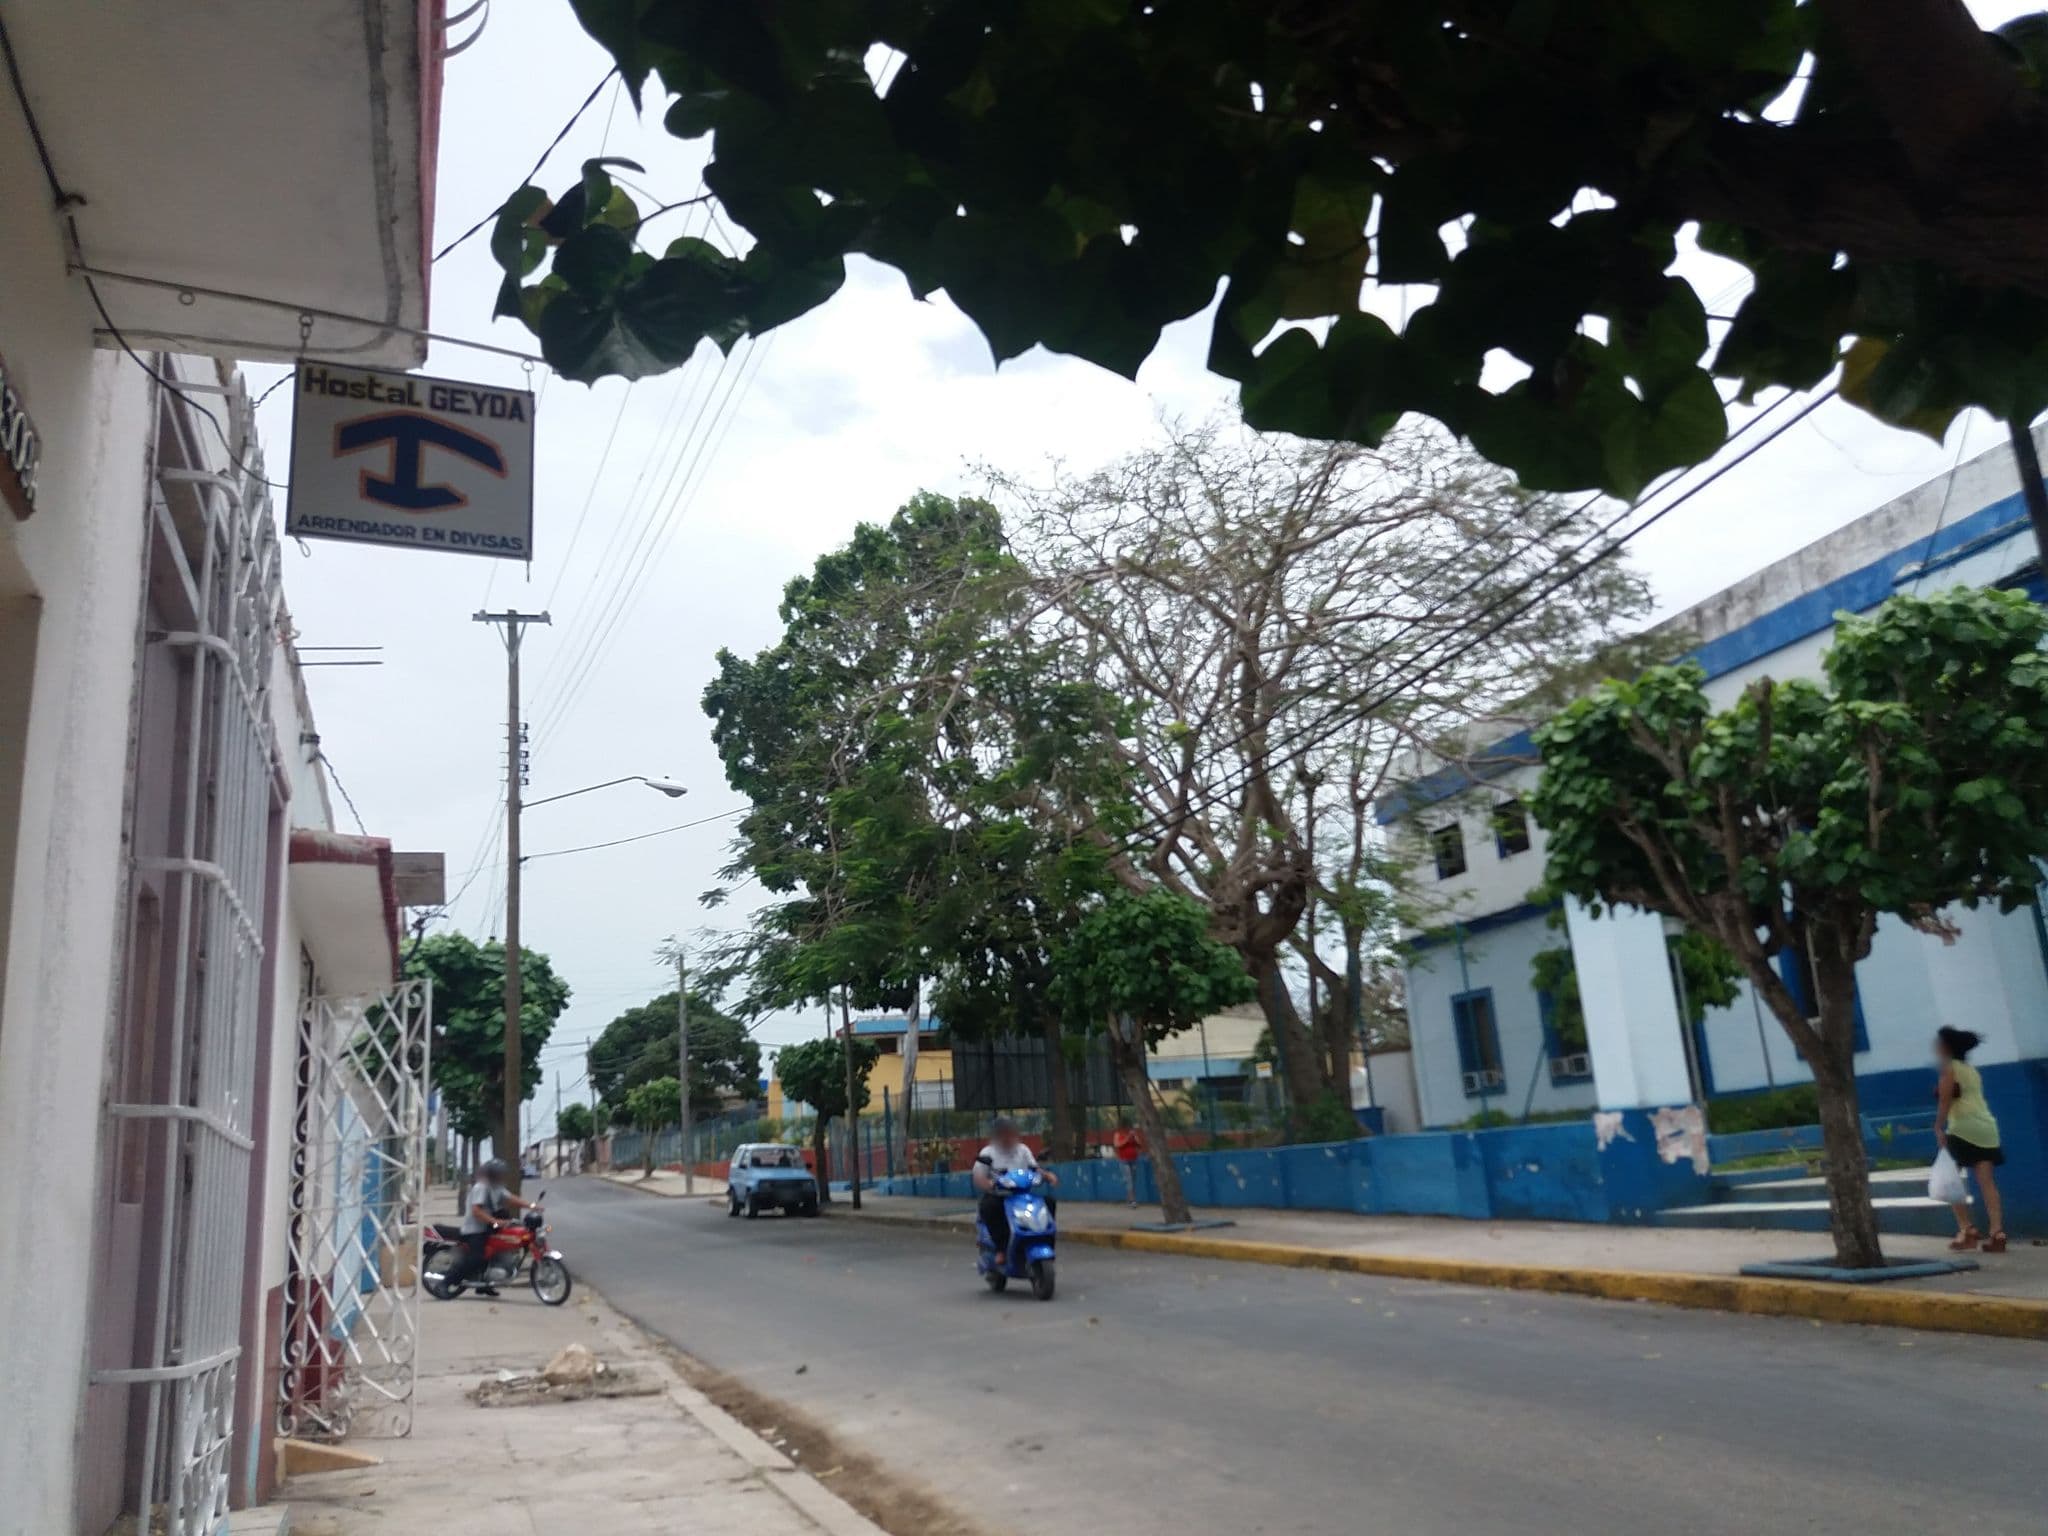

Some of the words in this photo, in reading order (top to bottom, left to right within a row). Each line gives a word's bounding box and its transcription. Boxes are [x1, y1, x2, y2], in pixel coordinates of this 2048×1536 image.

[429, 384, 527, 423] GEYDA
[298, 513, 416, 539] ARRENDADOR
[422, 527, 446, 542] EN
[451, 530, 524, 550] DIVISAS
